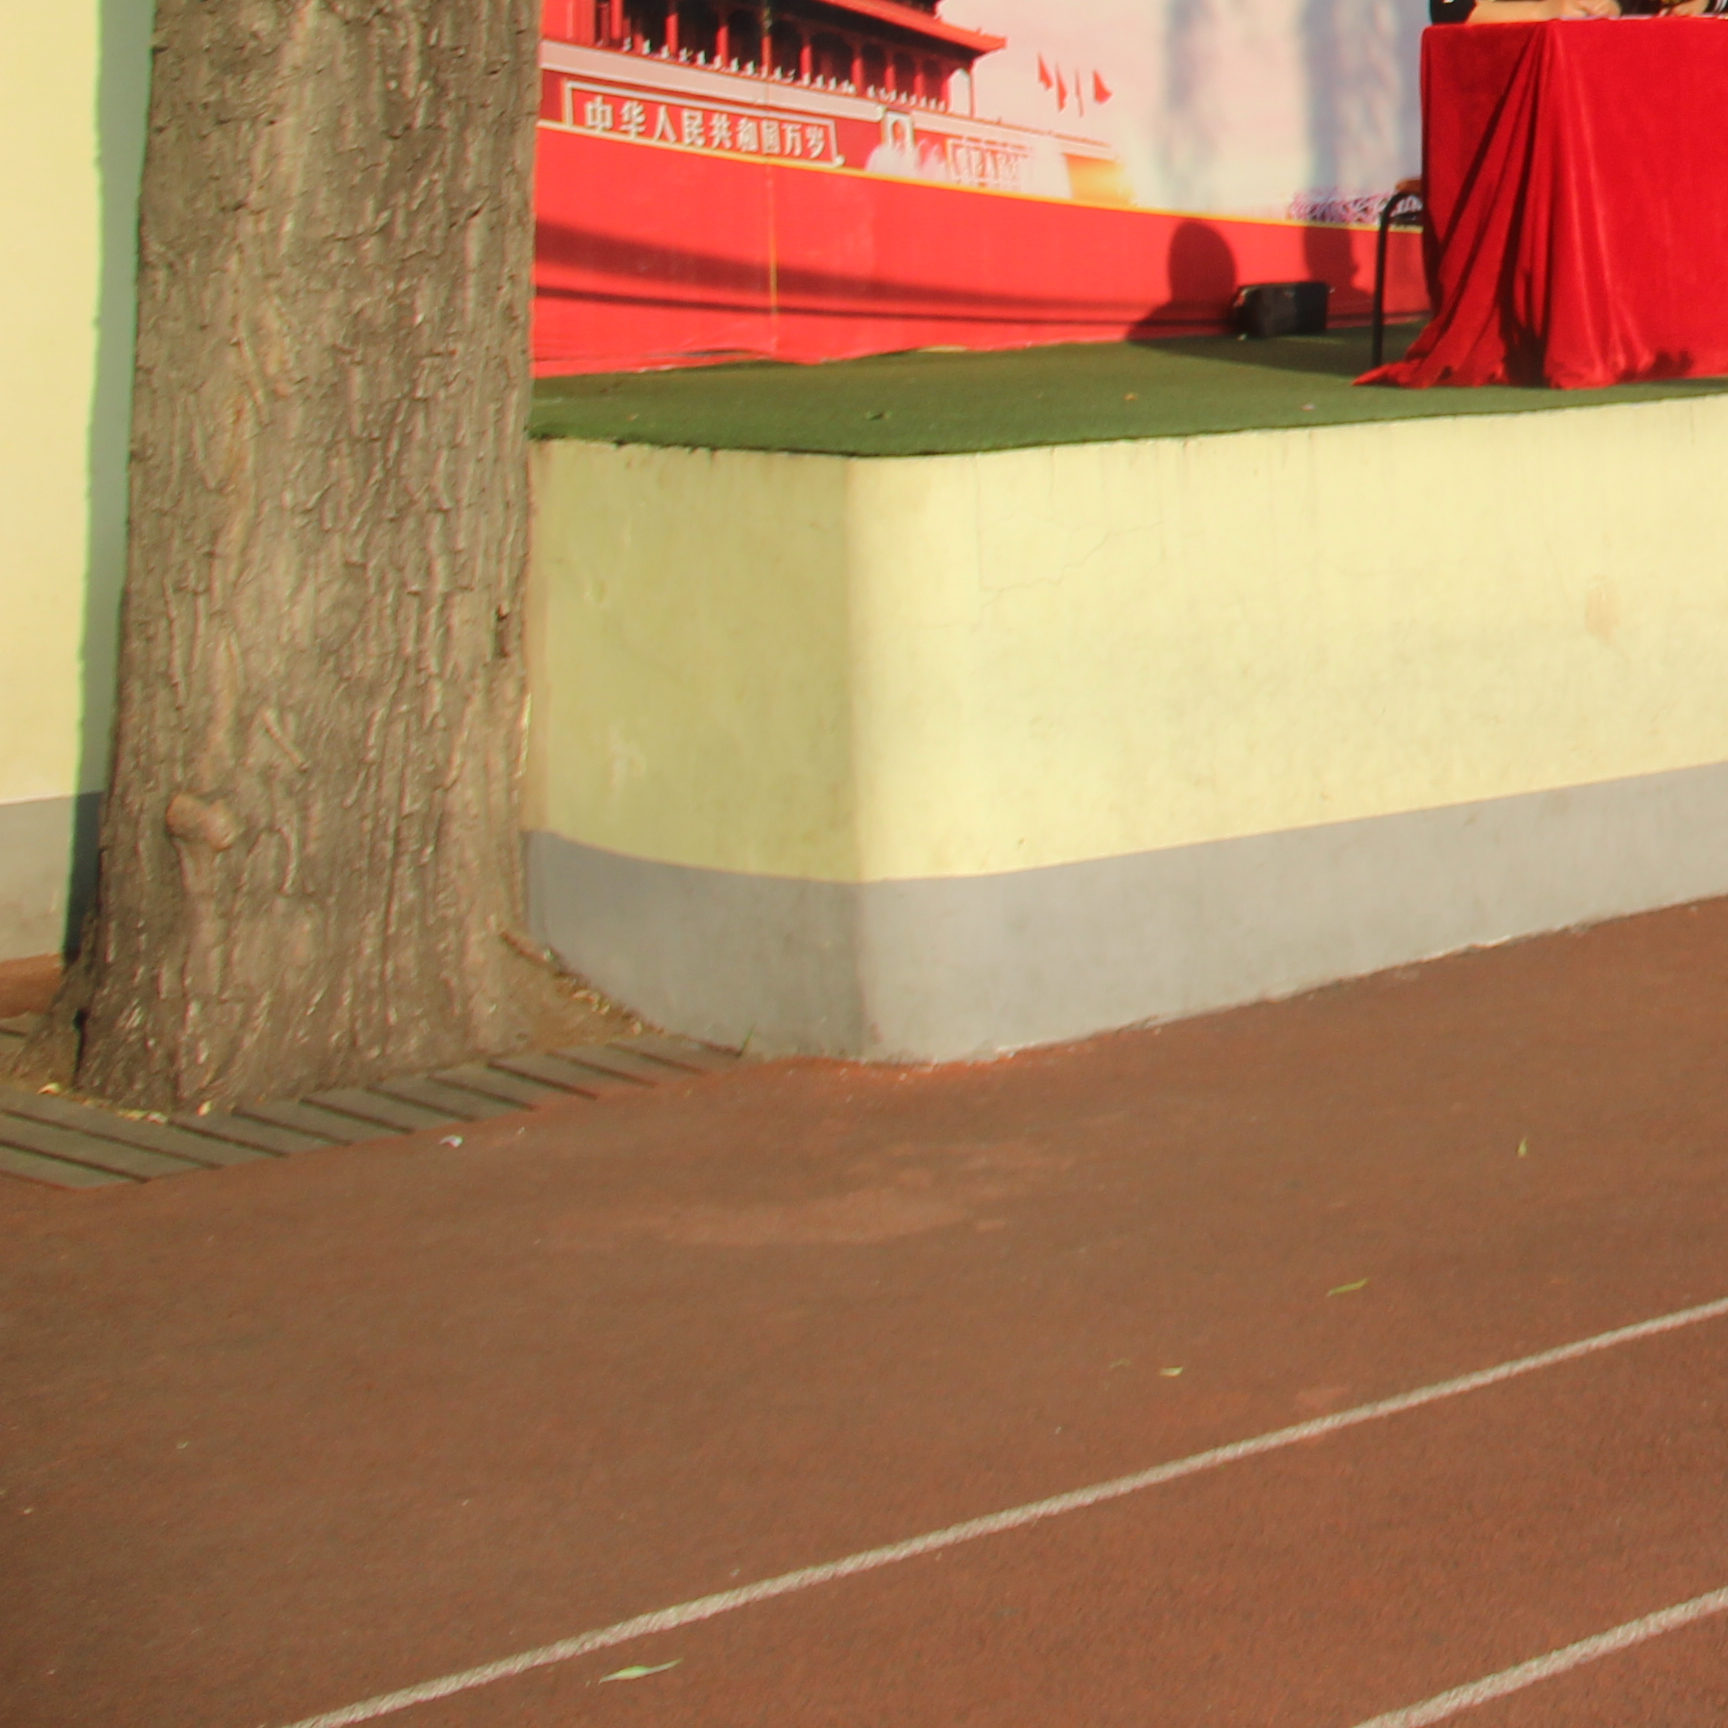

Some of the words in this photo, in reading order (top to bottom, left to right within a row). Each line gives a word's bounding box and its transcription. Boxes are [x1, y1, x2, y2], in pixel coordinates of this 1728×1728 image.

[584, 95, 826, 159] 中华人民共和国万岁
